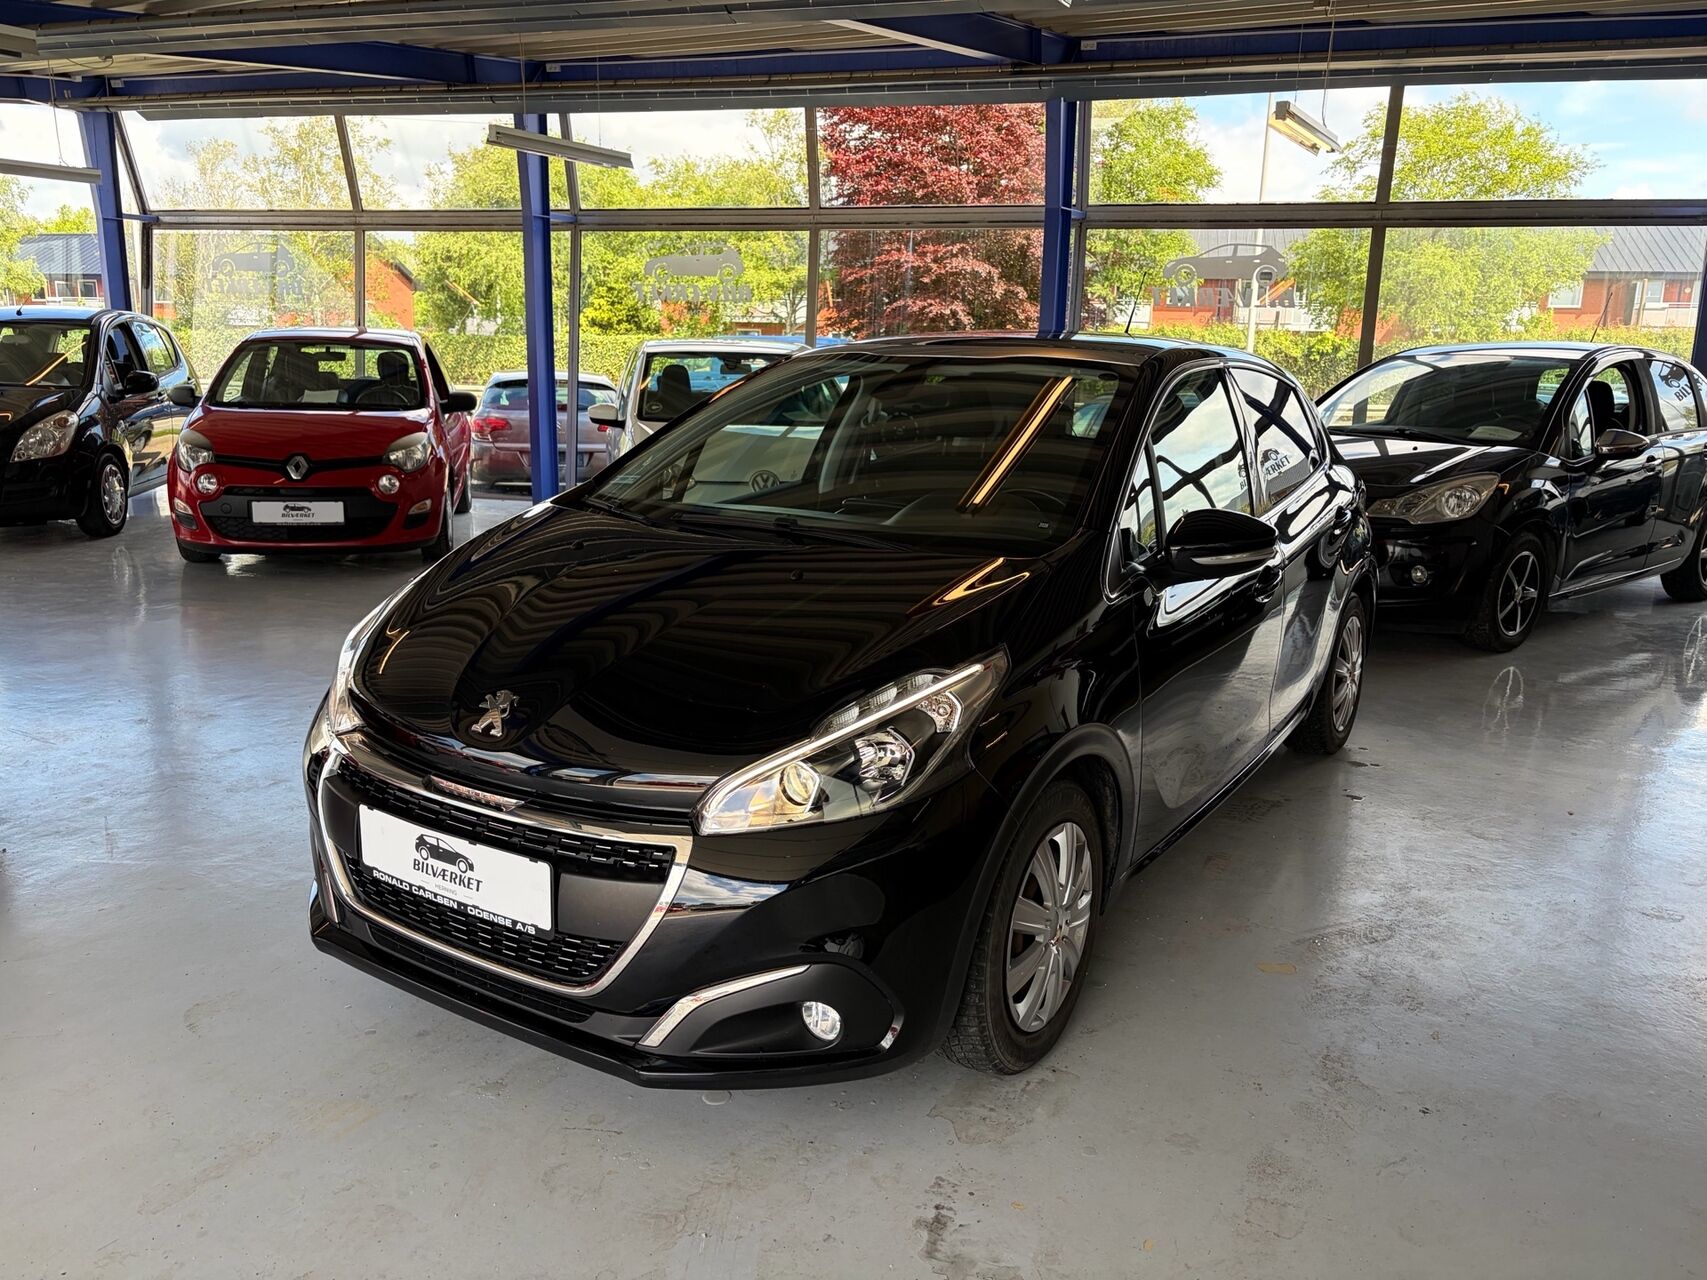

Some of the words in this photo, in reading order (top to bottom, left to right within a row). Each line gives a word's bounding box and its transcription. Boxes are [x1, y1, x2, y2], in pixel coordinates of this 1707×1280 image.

[413, 858, 483, 893] BILVÆRKET
[373, 869, 409, 890] RONALD
[411, 886, 458, 909] CARLSEN
[467, 906, 513, 928] ODENSE
[516, 922, 536, 935] A/S
